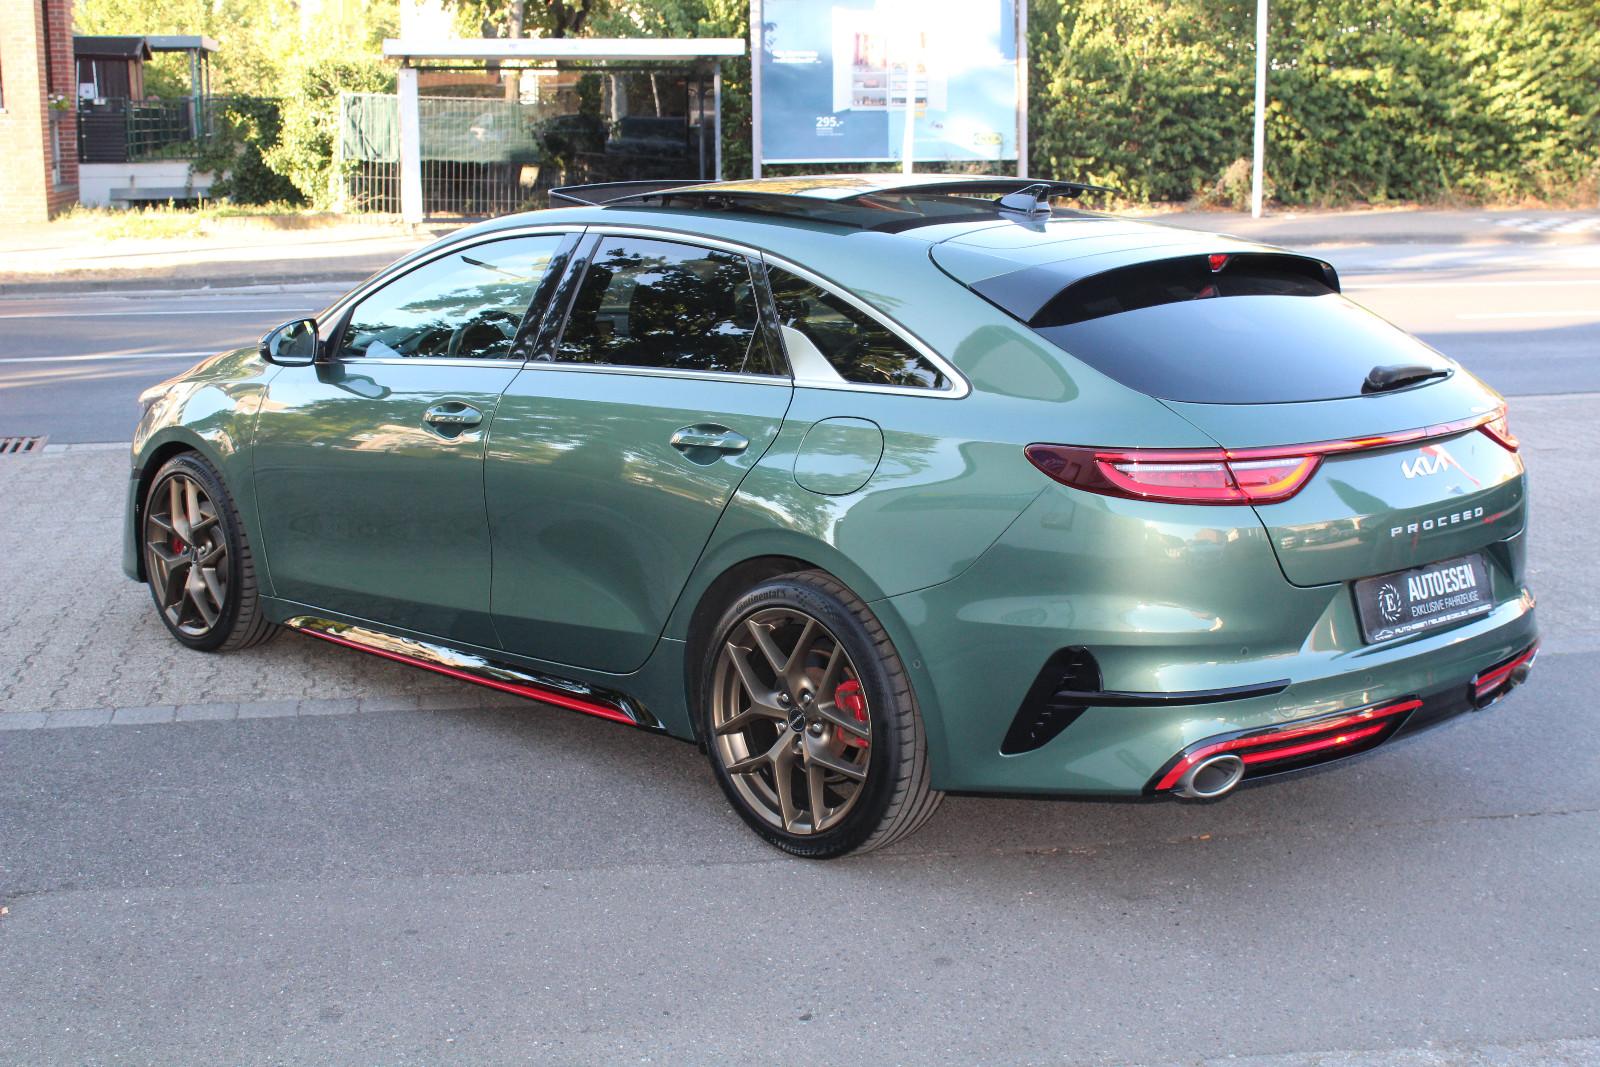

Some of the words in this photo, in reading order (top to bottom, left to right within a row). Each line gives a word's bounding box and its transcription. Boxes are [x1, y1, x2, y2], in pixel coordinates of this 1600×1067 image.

[1401, 454, 1449, 479] KIA
[1391, 506, 1484, 537] PROCEED
[1408, 563, 1476, 602] AUTOESEN
[1411, 602, 1445, 617] EXKLUSIVE
[1444, 590, 1480, 609] FAHRZEUGE
